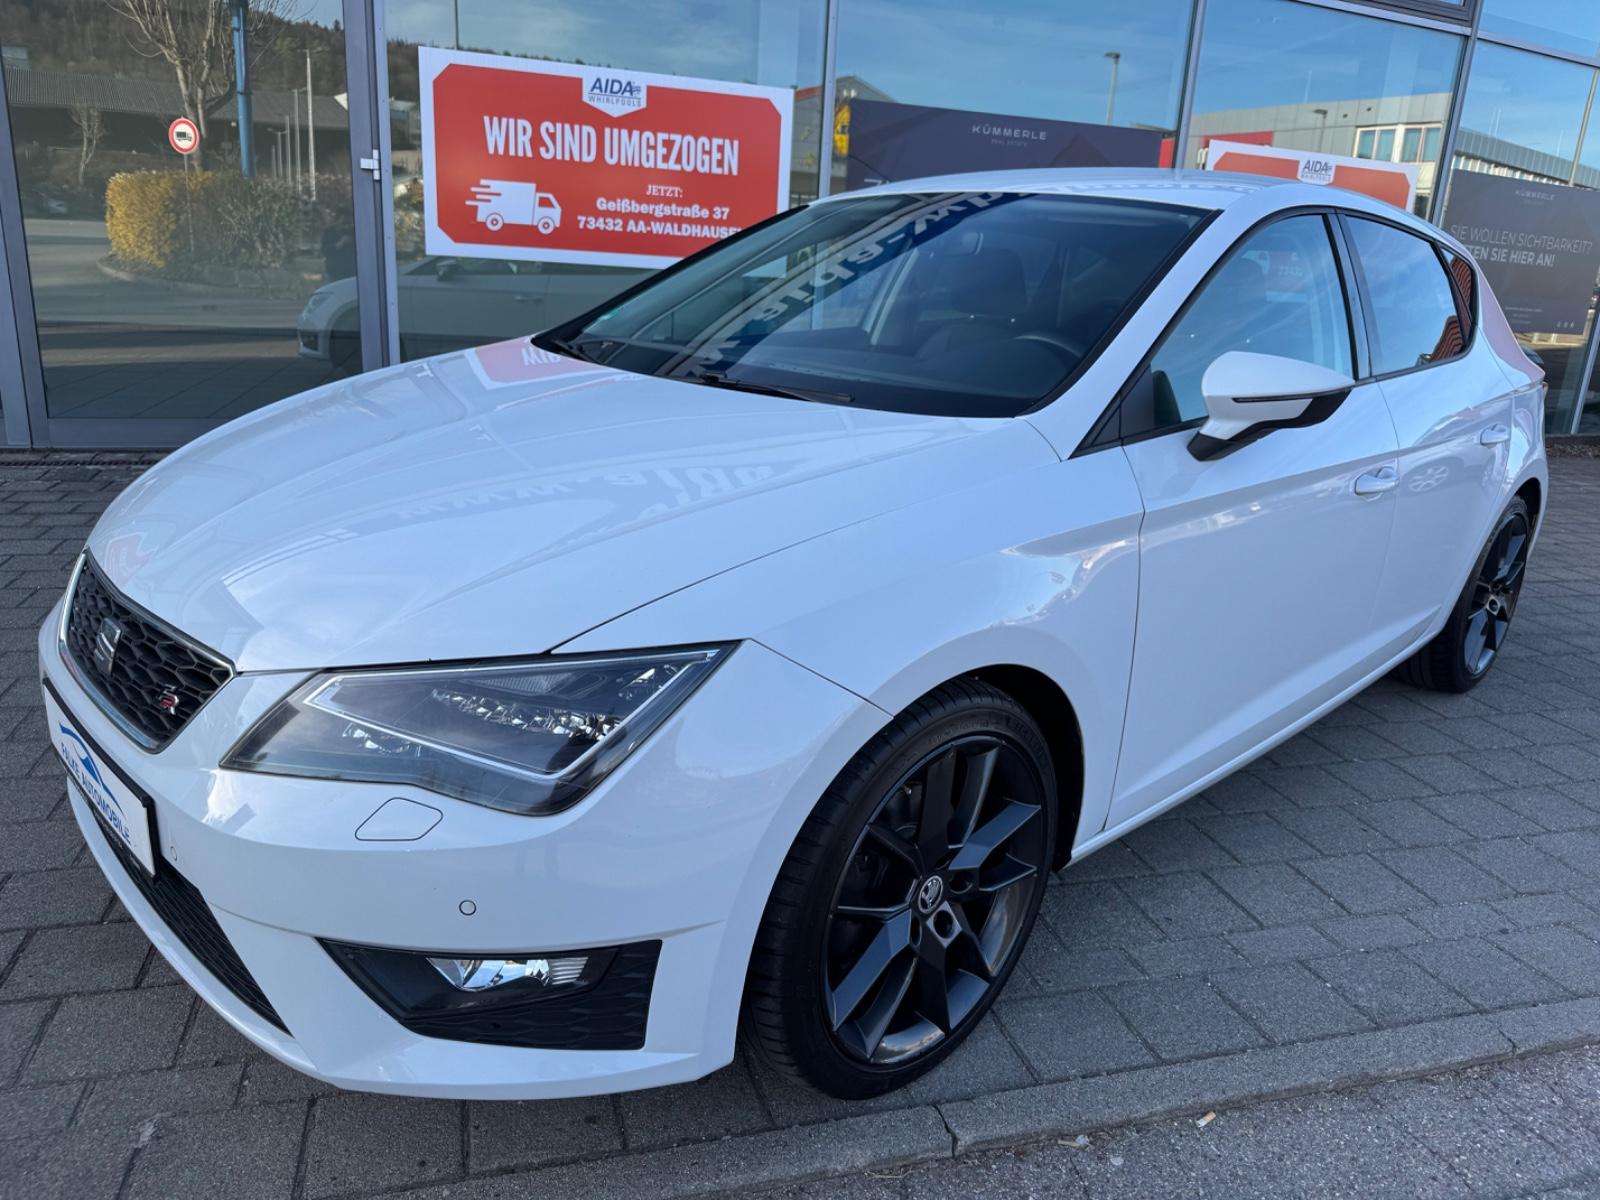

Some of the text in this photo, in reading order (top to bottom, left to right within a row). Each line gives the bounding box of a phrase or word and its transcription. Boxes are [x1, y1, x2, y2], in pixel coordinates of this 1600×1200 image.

[590, 77, 634, 97] AIDA
[587, 95, 642, 107] WHIRLPOOLS
[483, 115, 739, 176] WIR SIND UMGEZOGEN
[1302, 159, 1329, 174] AIDA
[646, 184, 683, 198] JETZT:
[596, 197, 730, 220] Geißbergstraße 37
[577, 215, 623, 232] 73432
[1470, 227, 1517, 246] WOLLEN
[1517, 232, 1593, 256] SICHTBARKEIT?
[1490, 247, 1509, 262] SIE
[1509, 250, 1536, 265] HIER
[1535, 253, 1556, 267] AN!
